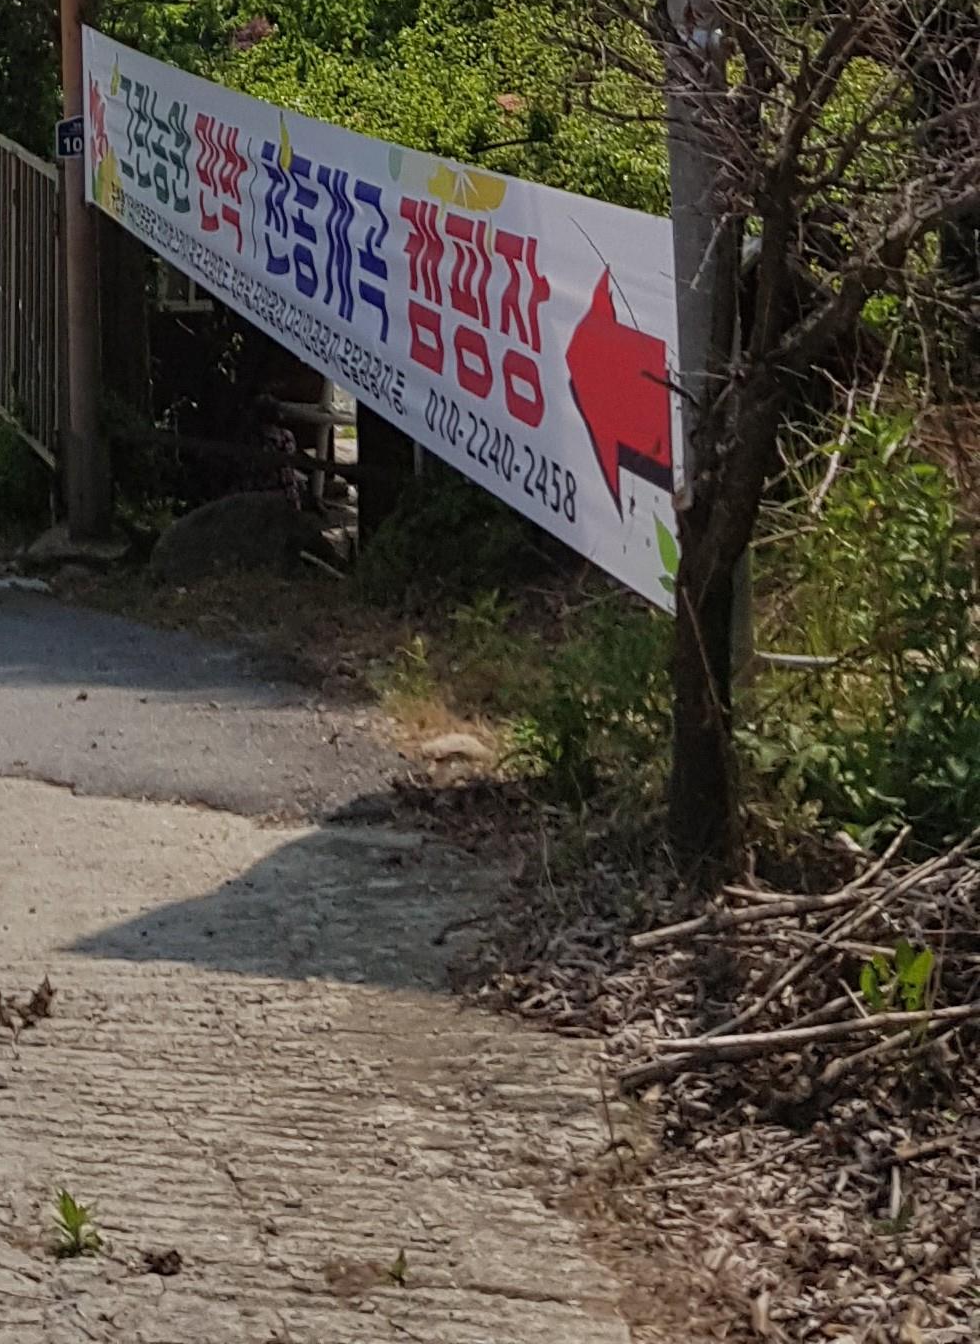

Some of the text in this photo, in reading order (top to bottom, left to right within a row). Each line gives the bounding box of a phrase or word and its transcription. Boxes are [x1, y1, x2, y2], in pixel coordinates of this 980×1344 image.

[120, 74, 192, 213] 그린농원
[195, 113, 249, 255] 민박
[260, 139, 390, 345] 천동계곡
[399, 195, 552, 429] 캠핑장
[425, 387, 578, 524] 010-2240-2458
